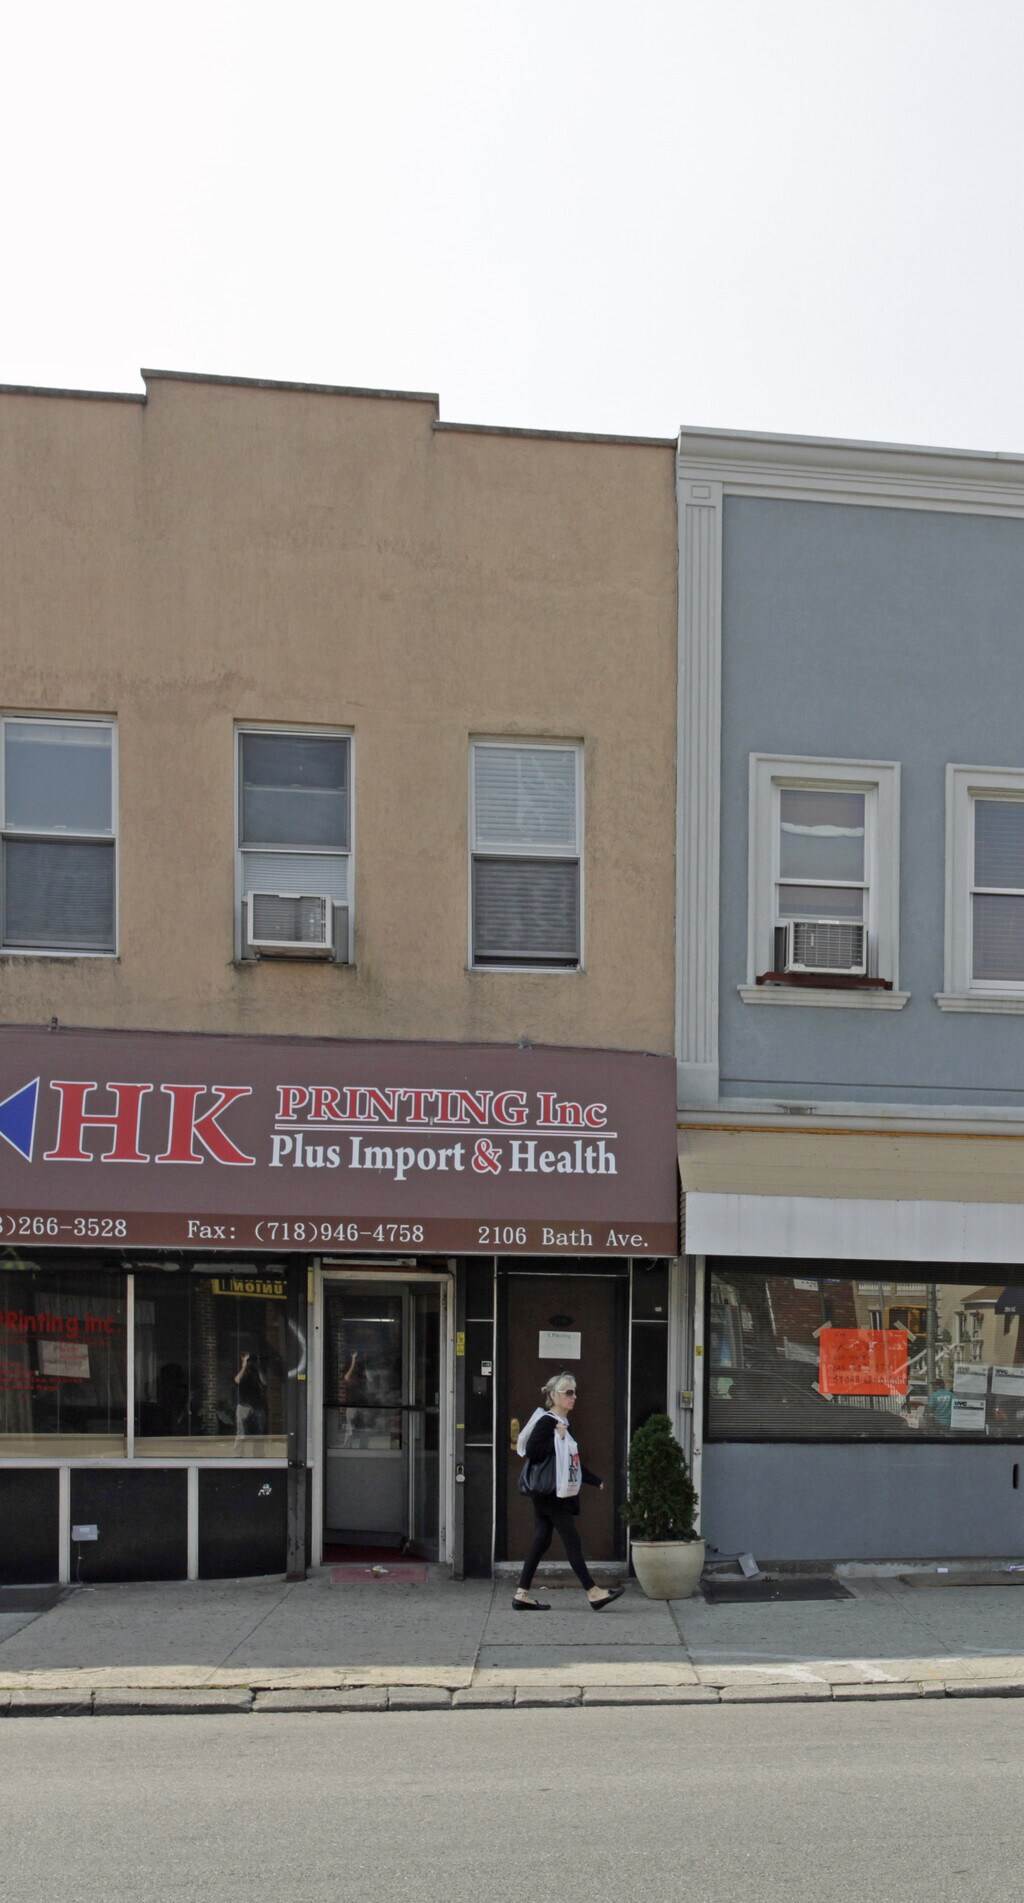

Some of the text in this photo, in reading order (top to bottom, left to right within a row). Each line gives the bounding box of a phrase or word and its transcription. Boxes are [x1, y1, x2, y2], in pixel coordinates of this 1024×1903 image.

[43, 1080, 256, 1166] HK
[275, 1085, 608, 1128] PRINTING Inc
[269, 1133, 618, 1181] Plus Import & Health
[187, 1220, 236, 1240] Fax:
[254, 1221, 425, 1243] (718)946-4758
[478, 1226, 527, 1245] 2106
[542, 1227, 593, 1247] Bath
[605, 1229, 649, 1247] Ave.
